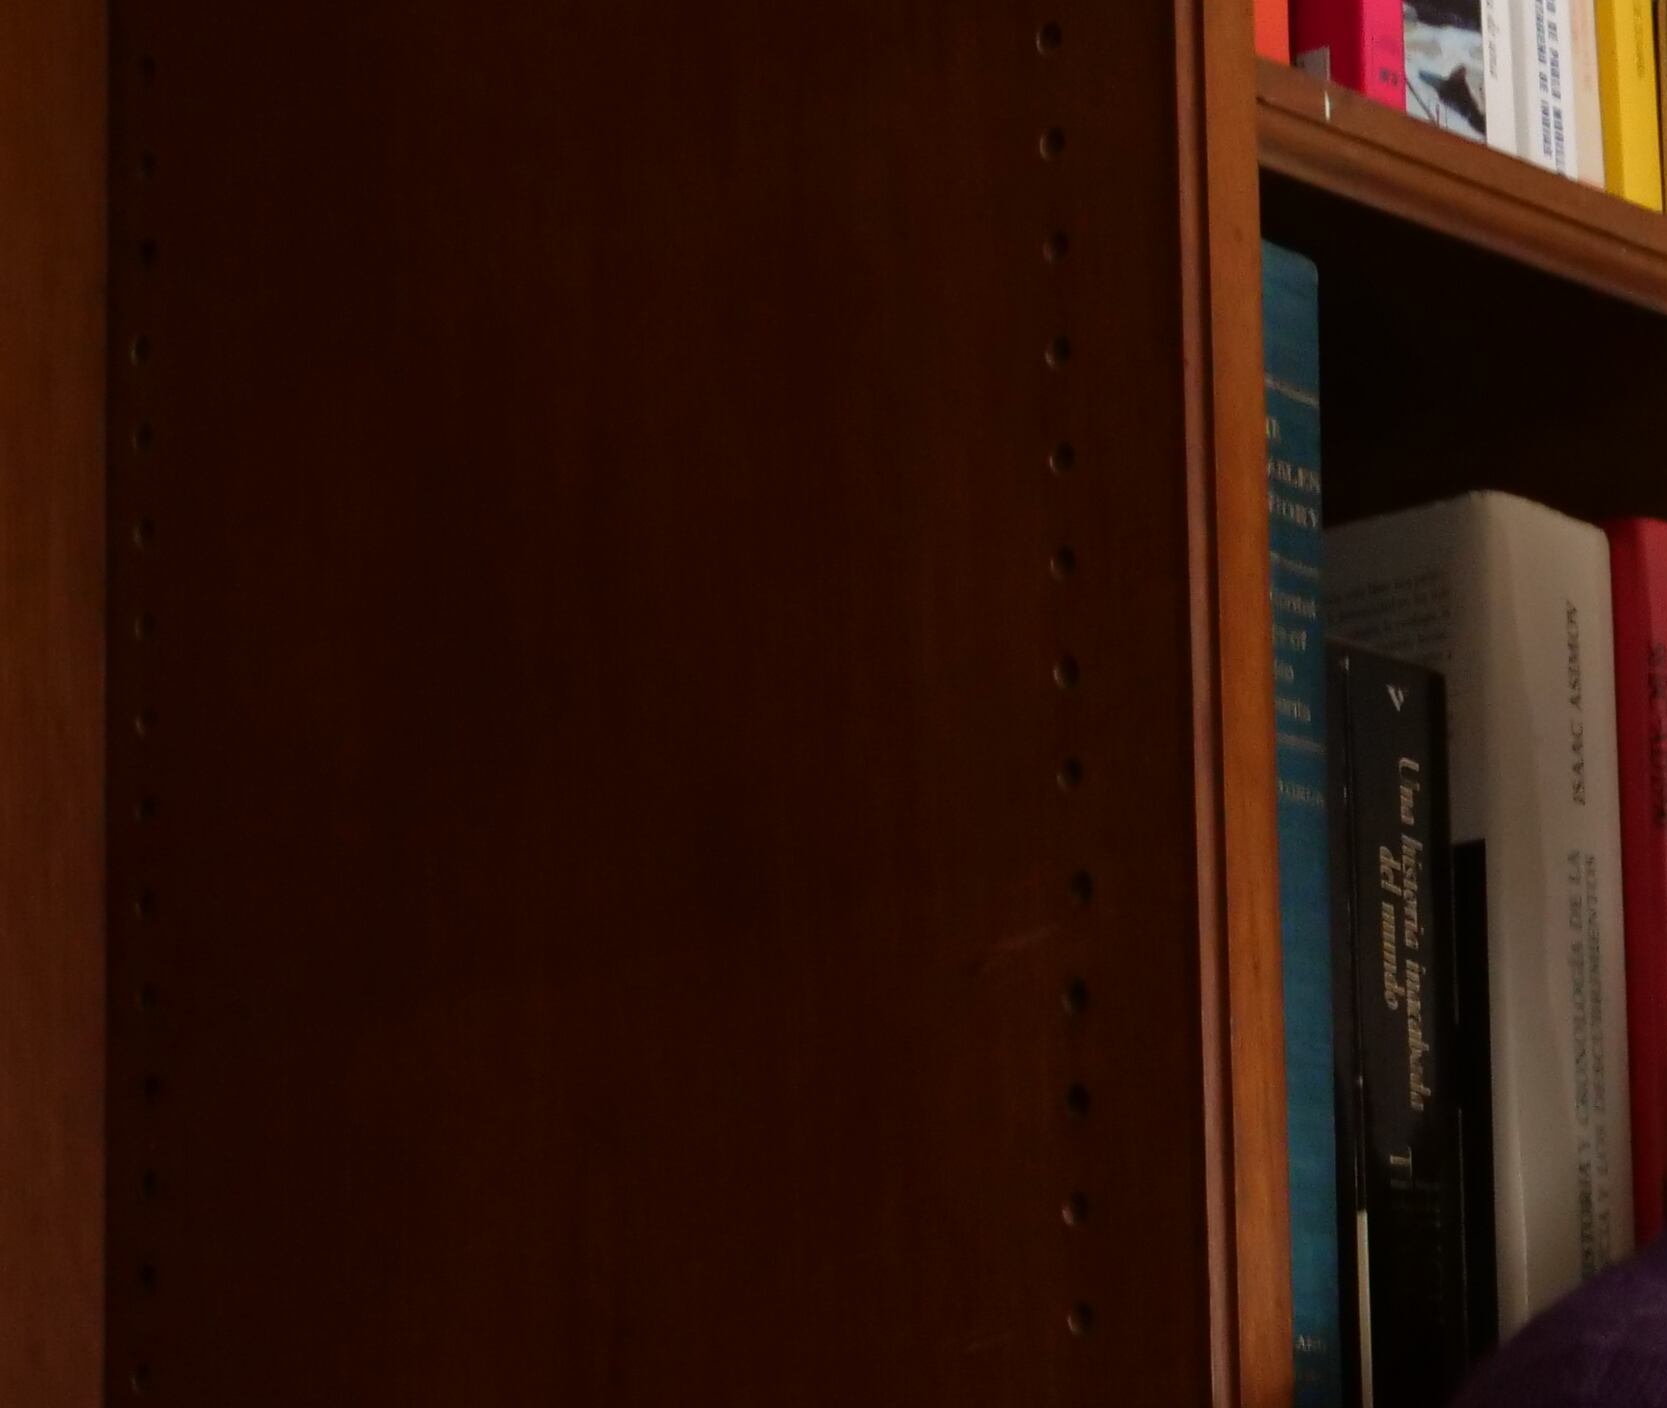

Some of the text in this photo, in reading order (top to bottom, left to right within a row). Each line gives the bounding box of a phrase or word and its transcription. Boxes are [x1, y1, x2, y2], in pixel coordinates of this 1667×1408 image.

[1570, 719, 1586, 806] ISAAC
[1378, 846, 1406, 1011] del mundo
[1399, 757, 1432, 1112] Una historia inacabada
[1577, 1160, 1596, 1277] STORIA
